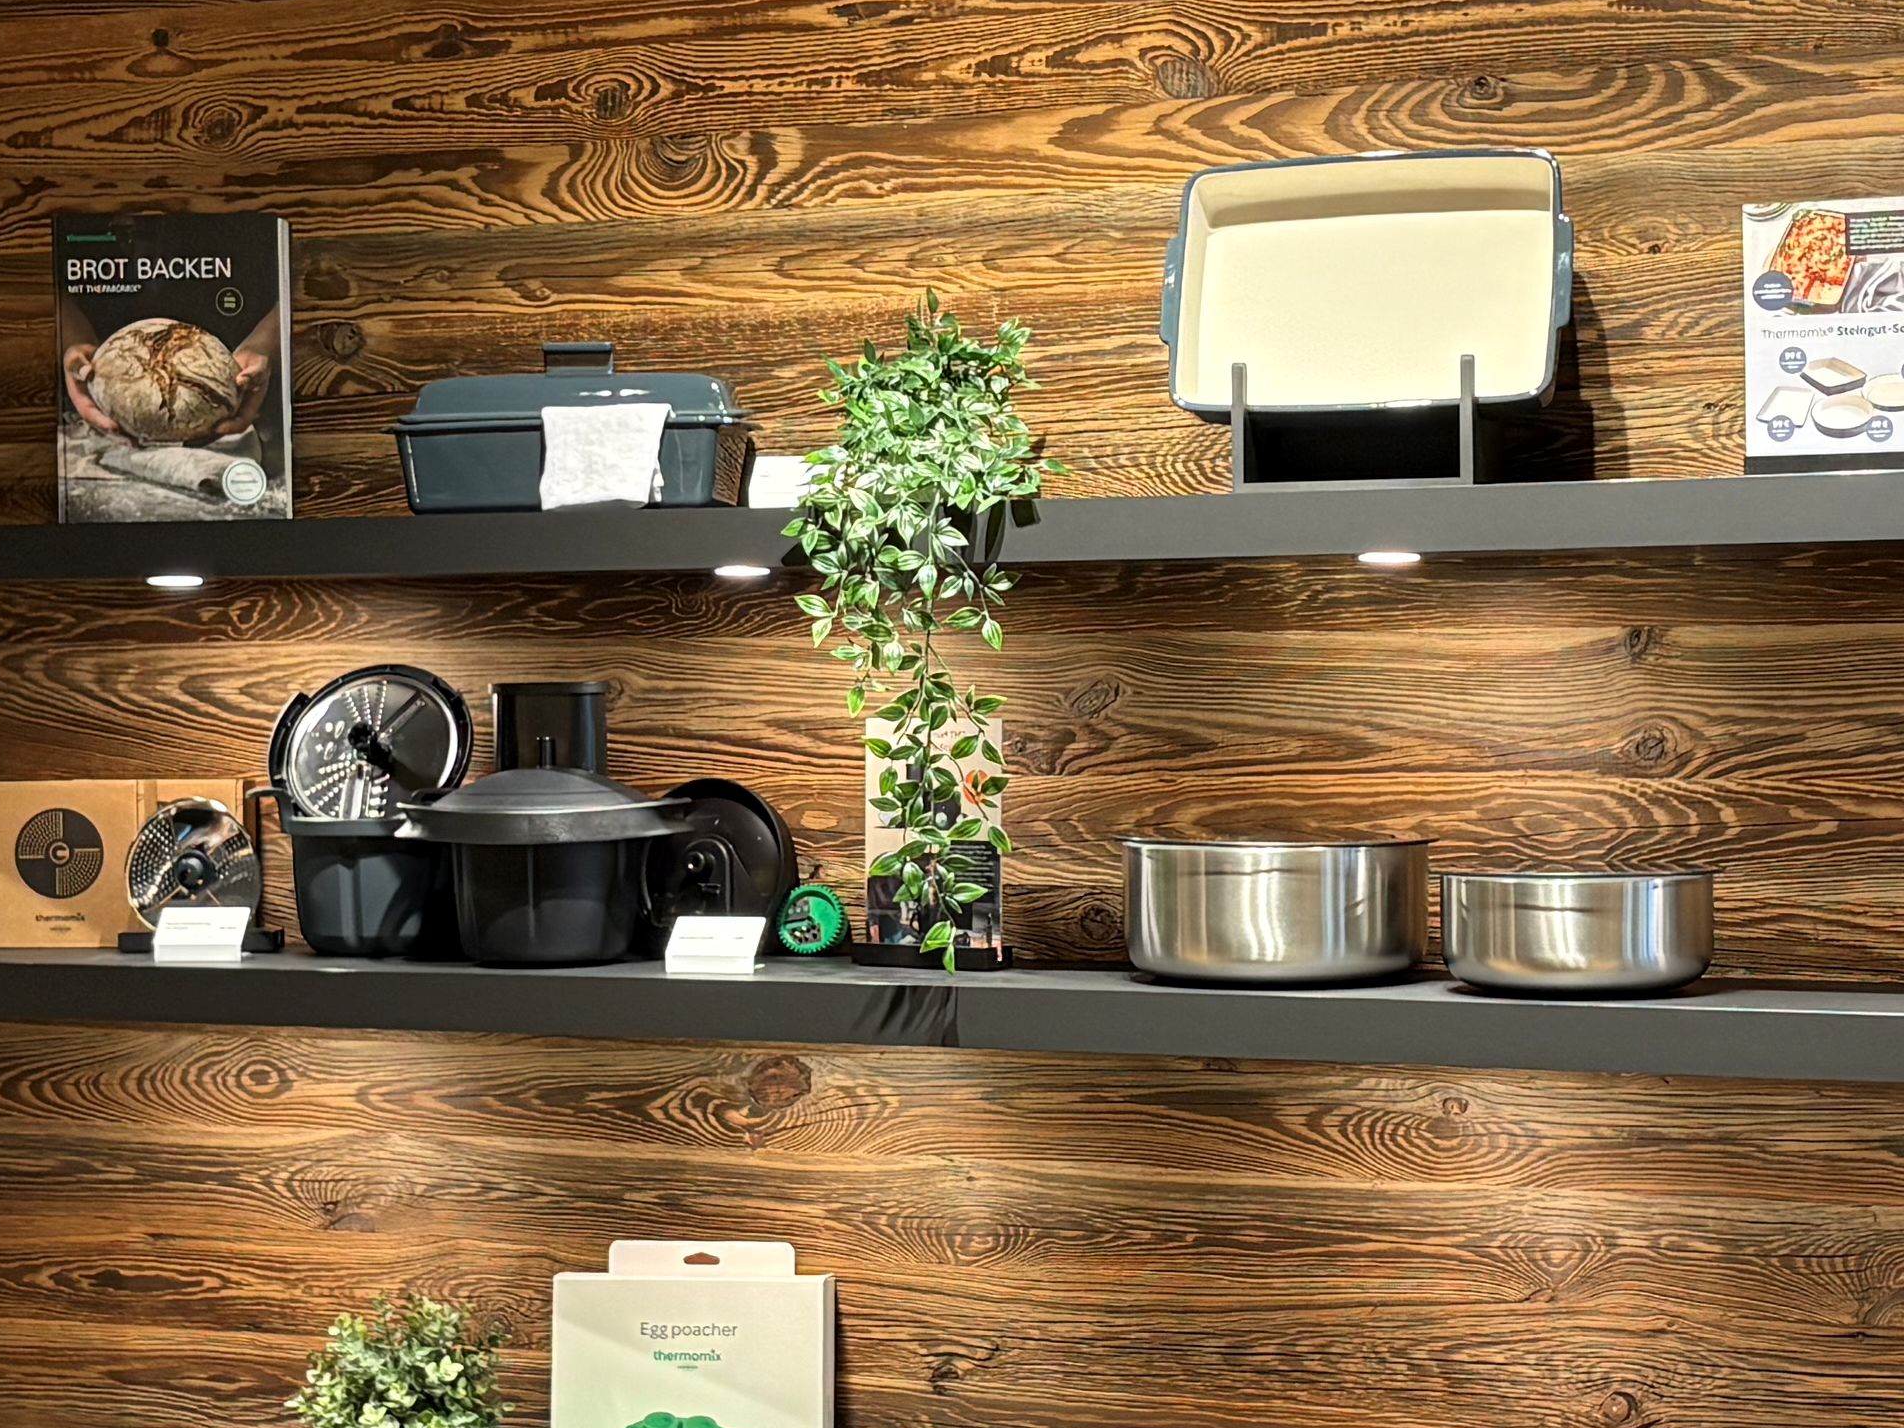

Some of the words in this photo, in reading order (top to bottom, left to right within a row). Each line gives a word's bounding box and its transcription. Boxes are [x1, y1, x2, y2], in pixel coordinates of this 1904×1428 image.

[67, 258, 129, 281] BROT
[136, 257, 232, 280] BACKEN
[34, 912, 86, 923] thermomix
[640, 1321, 669, 1340] Egg
[671, 1322, 739, 1339] poacher
[653, 1348, 722, 1362] thermomix
